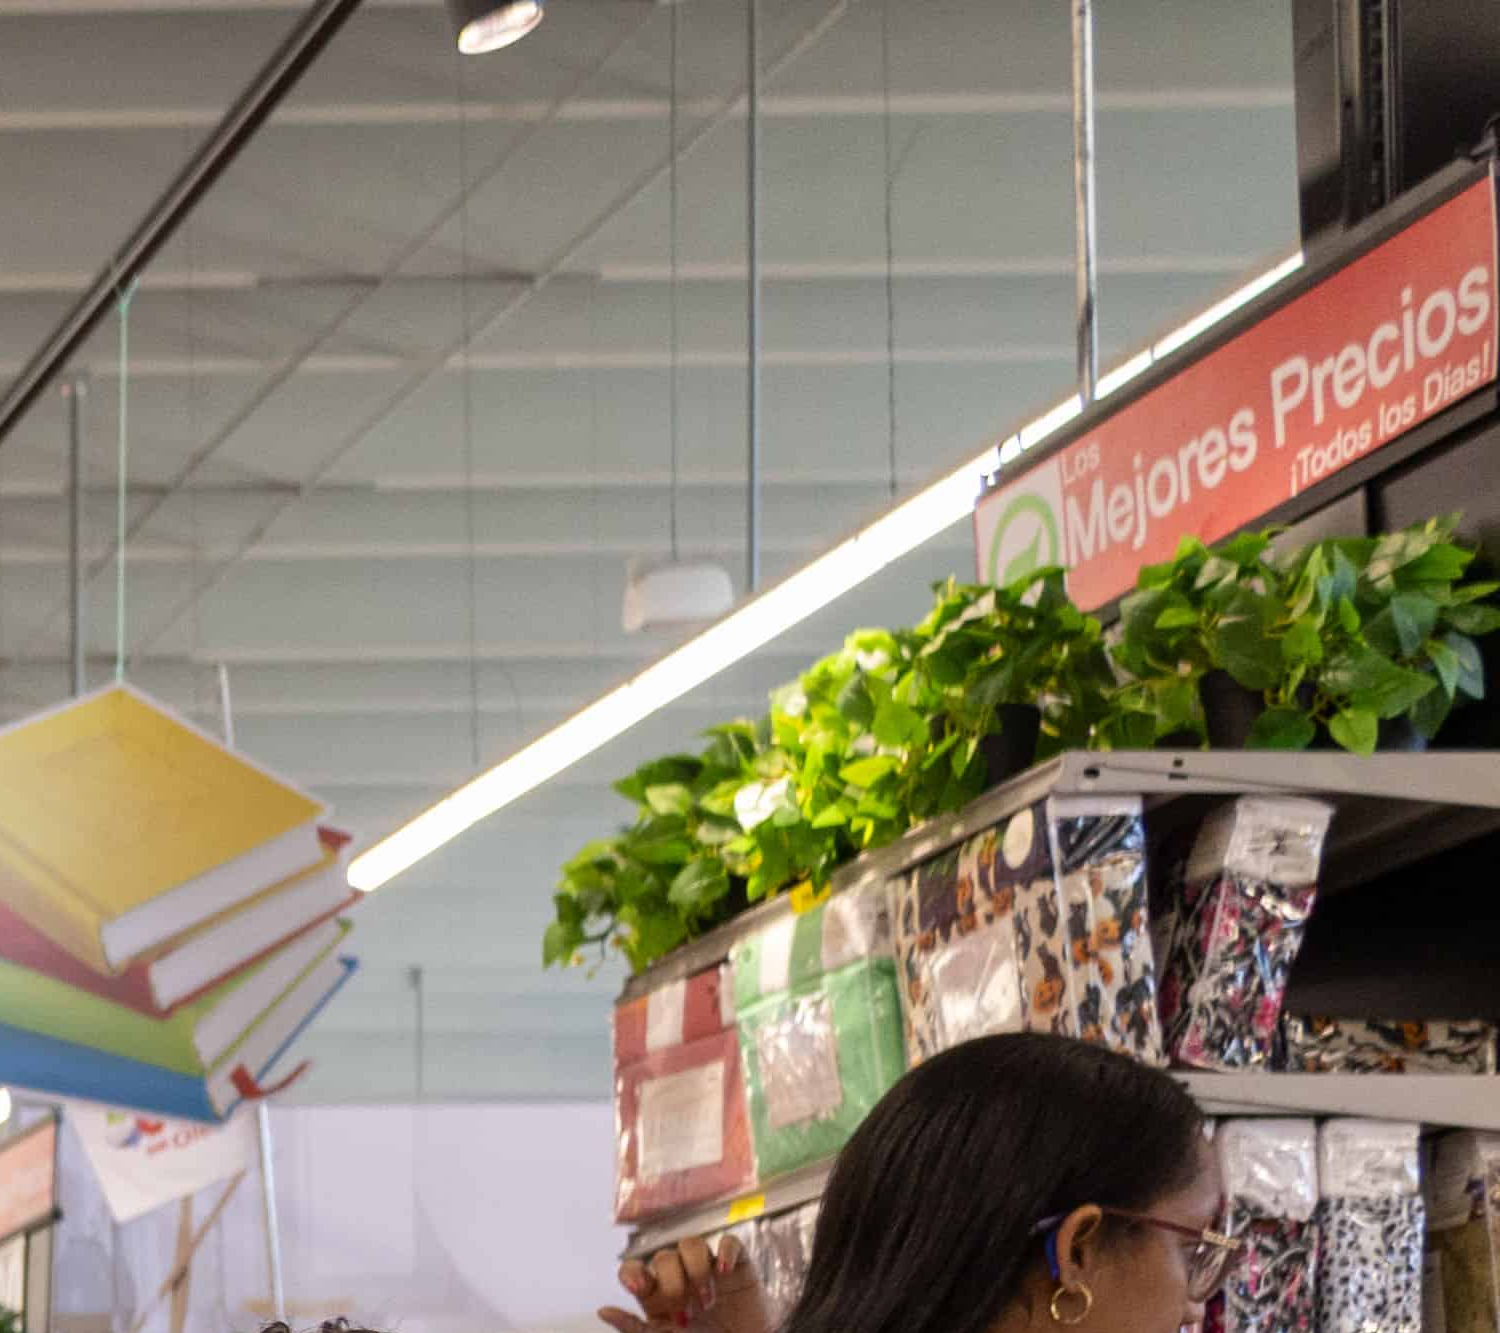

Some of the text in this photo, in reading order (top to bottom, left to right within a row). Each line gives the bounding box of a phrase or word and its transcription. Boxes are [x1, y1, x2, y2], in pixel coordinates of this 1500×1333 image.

[1064, 264, 1491, 570] Mejores Precios
[1378, 393, 1416, 441] los
[1423, 339, 1491, 413] Días!
[1062, 440, 1100, 484] Los
